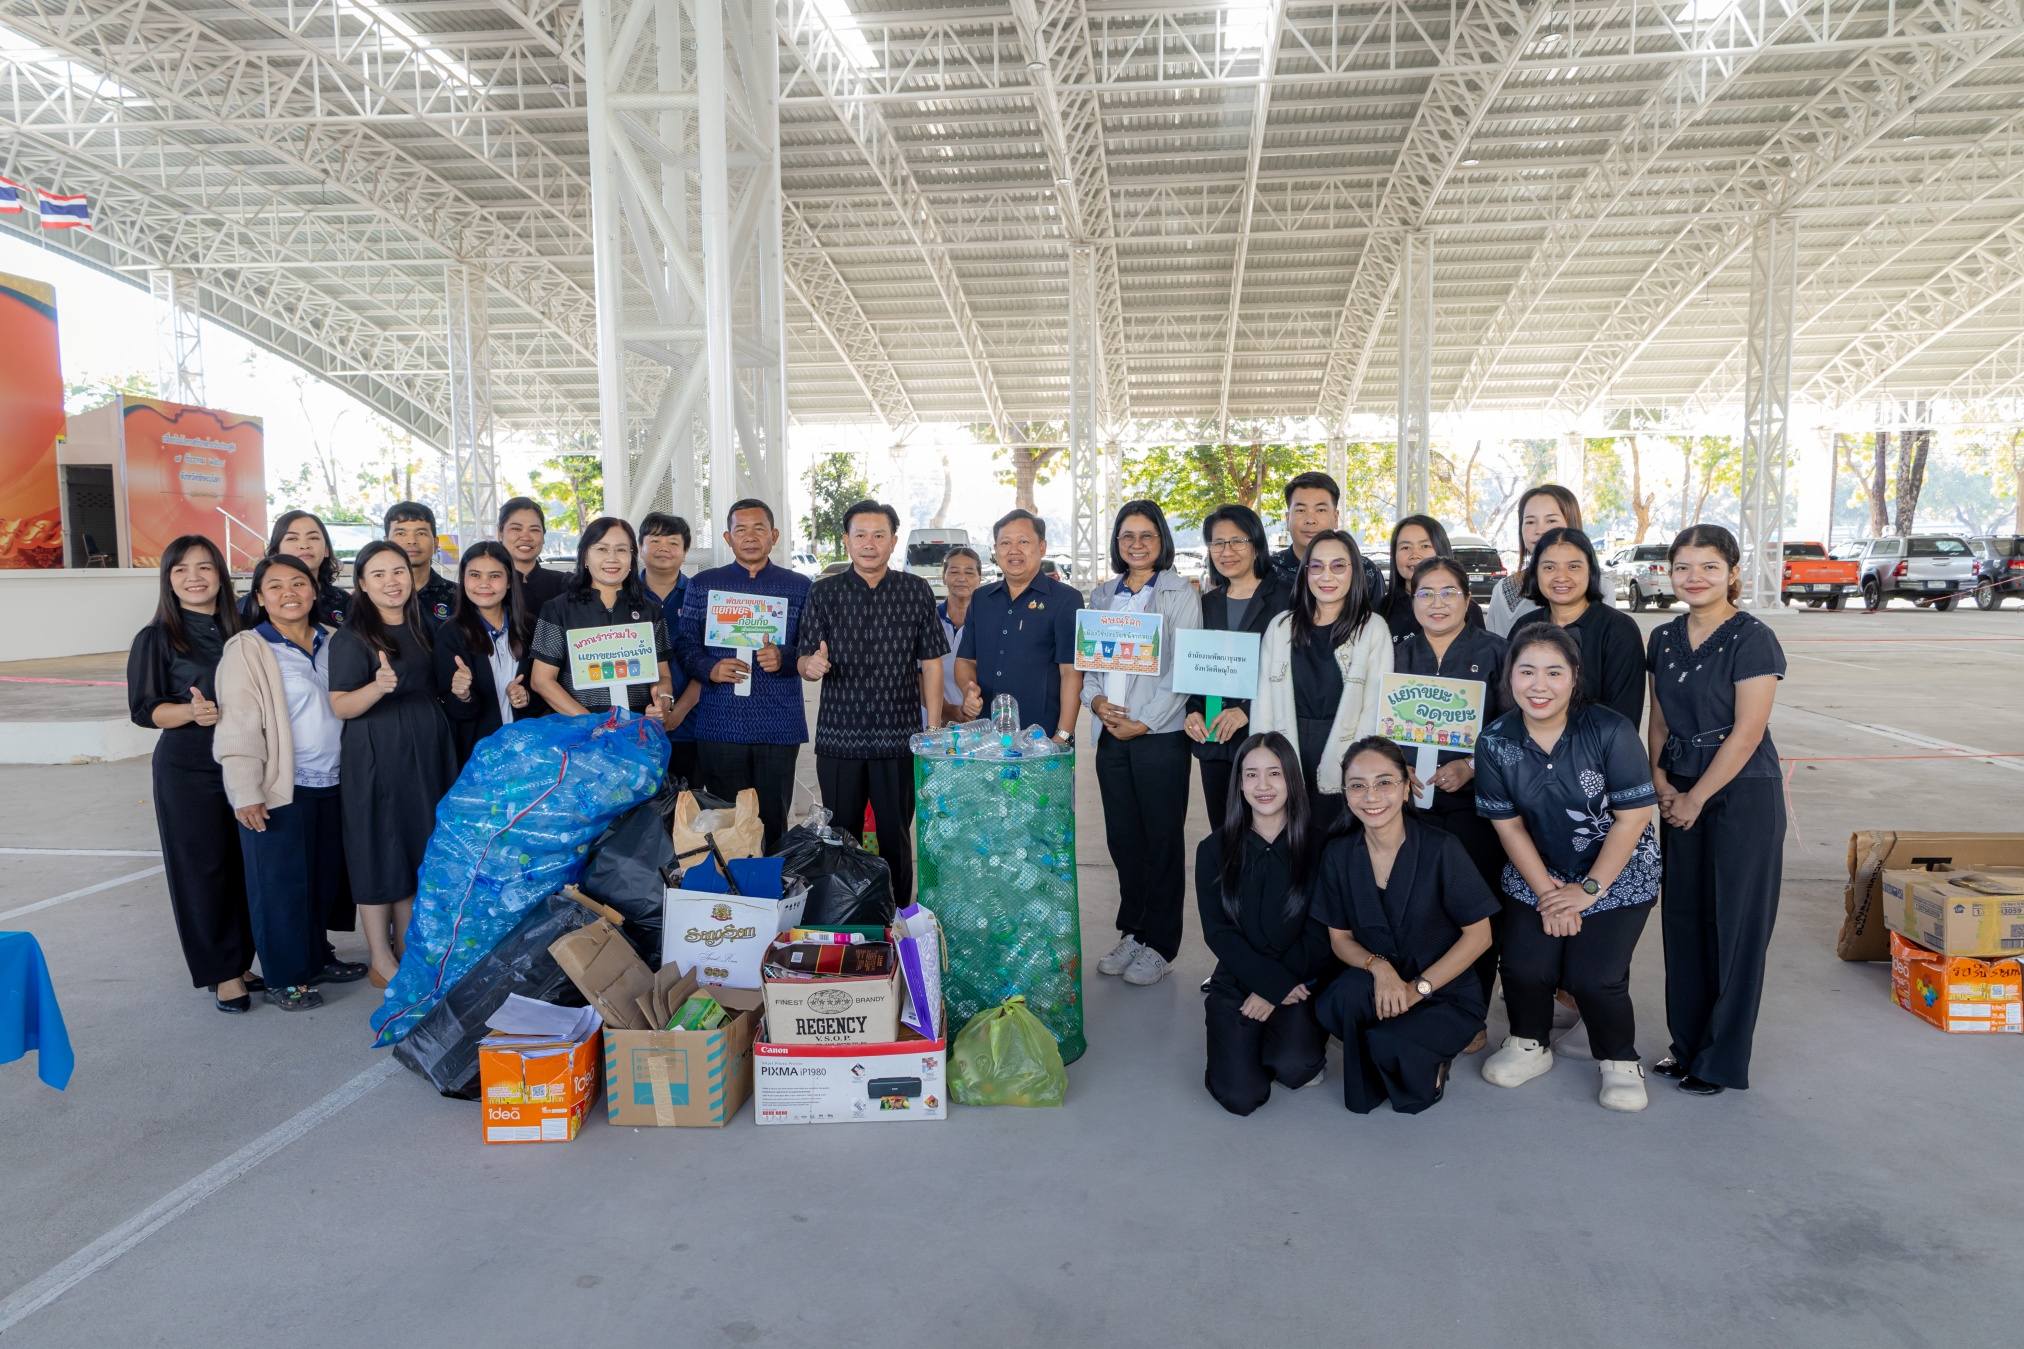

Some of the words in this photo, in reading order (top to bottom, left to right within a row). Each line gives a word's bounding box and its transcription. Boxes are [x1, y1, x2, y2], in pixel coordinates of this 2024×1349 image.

[575, 628, 637, 649] พวกเราร่วมใจ
[578, 640, 653, 661] แยกขยะก่อนทิ้ง
[1187, 650, 1247, 664] สำนักงานพัฒนาชุมชน
[1194, 663, 1238, 676] จังหวัดพิษณุโลก
[1387, 686, 1453, 705] แยกขยะ
[1416, 703, 1476, 723] ลดขยะ
[855, 996, 885, 1004] BRANDY
[795, 1015, 868, 1036] REGENCY
[760, 1046, 789, 1055] Canon
[761, 1066, 798, 1077] PIXMA
[800, 1067, 827, 1077] iP1980
